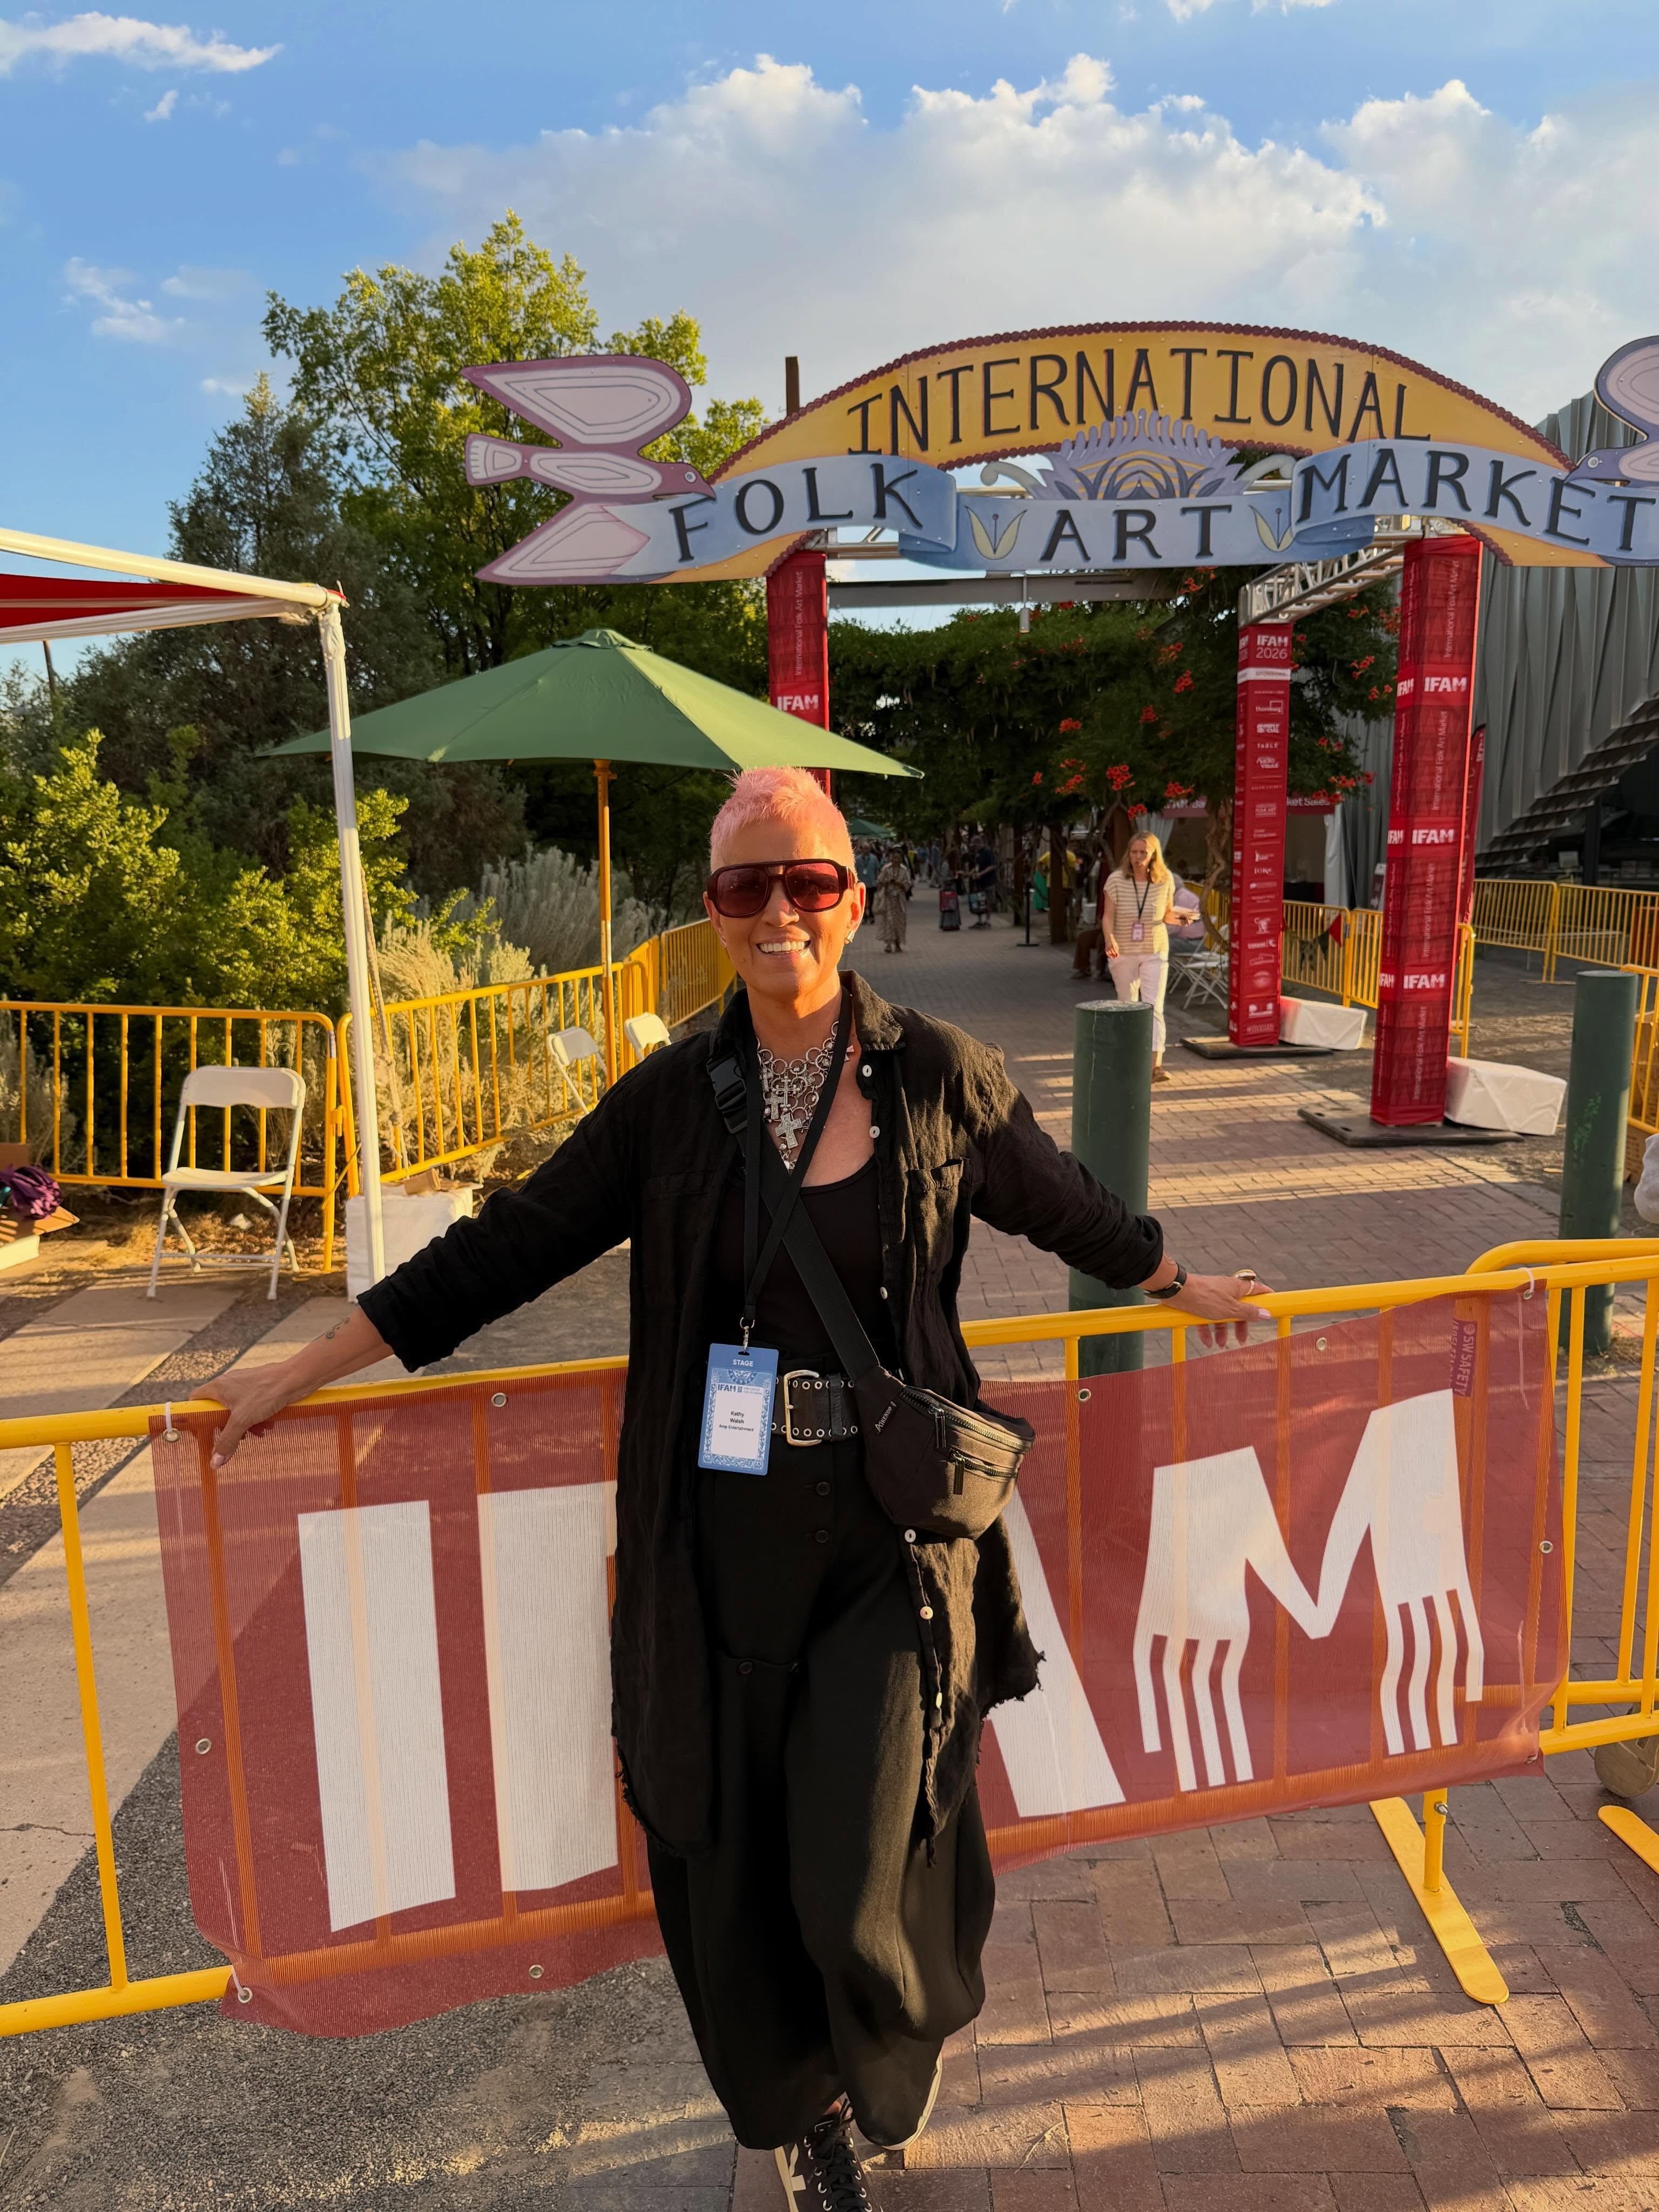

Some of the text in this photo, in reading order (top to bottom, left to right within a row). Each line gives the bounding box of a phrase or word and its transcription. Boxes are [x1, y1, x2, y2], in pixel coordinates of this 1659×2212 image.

[847, 348, 1431, 455] INTERNATIONAL
[1296, 448, 1657, 551] MARKET
[669, 462, 923, 562] FOLK
[1040, 504, 1232, 561] ART
[795, 571, 803, 597] Market
[795, 612, 803, 628] Folk
[1257, 635, 1289, 647] IFAM
[795, 630, 803, 675] International
[1256, 648, 1287, 659] 2026
[1397, 678, 1414, 697] IFAM
[1424, 677, 1467, 692] IFAM
[777, 694, 819, 711] IFAM
[1387, 830, 1404, 845] IFAM
[1412, 829, 1454, 844] IFAM
[1404, 974, 1445, 989] IFAM
[732, 1359, 754, 1367] STAGE
[1454, 1353, 1472, 1397] SAFETY
[717, 1384, 736, 1392] IFAM
